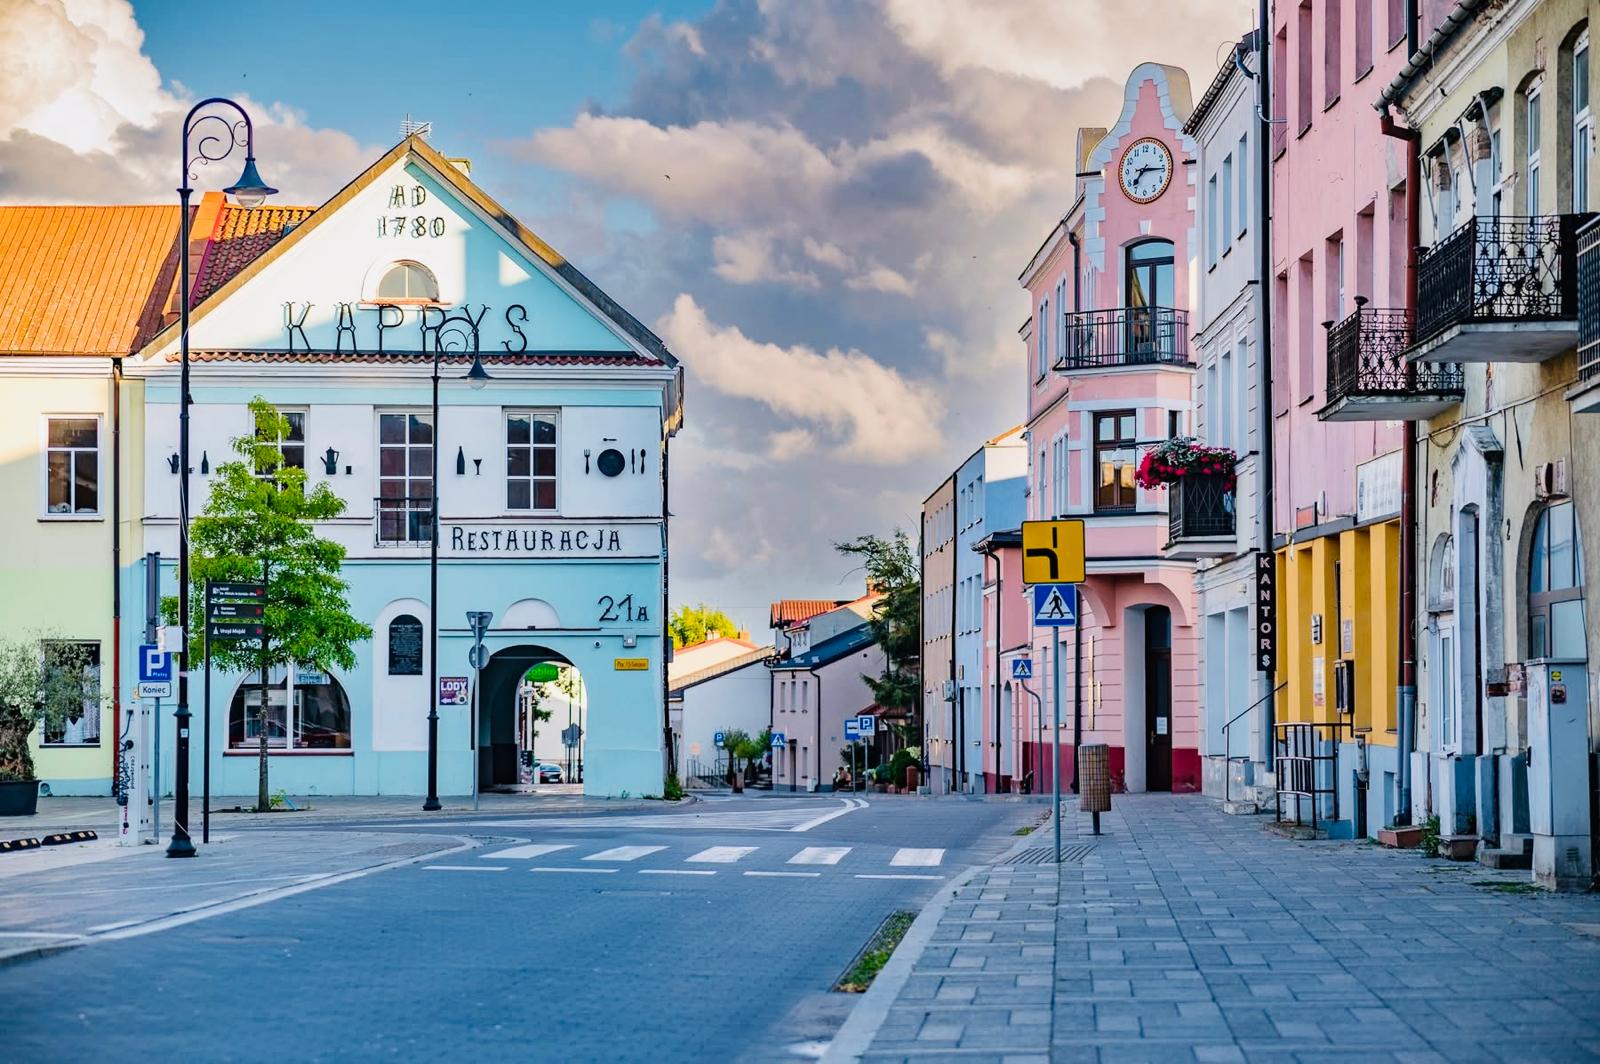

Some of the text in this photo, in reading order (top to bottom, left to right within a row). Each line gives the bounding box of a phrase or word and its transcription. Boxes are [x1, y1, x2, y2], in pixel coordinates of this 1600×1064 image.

[1142, 144, 1149, 152] 12
[393, 184, 426, 207] AD
[381, 215, 445, 237] 1780
[281, 300, 530, 355] KAPRYS
[1506, 518, 1511, 541] 2
[146, 648, 165, 677] P
[142, 686, 166, 694] Koniec
[440, 681, 467, 691] LODY
[862, 718, 870, 729] P
